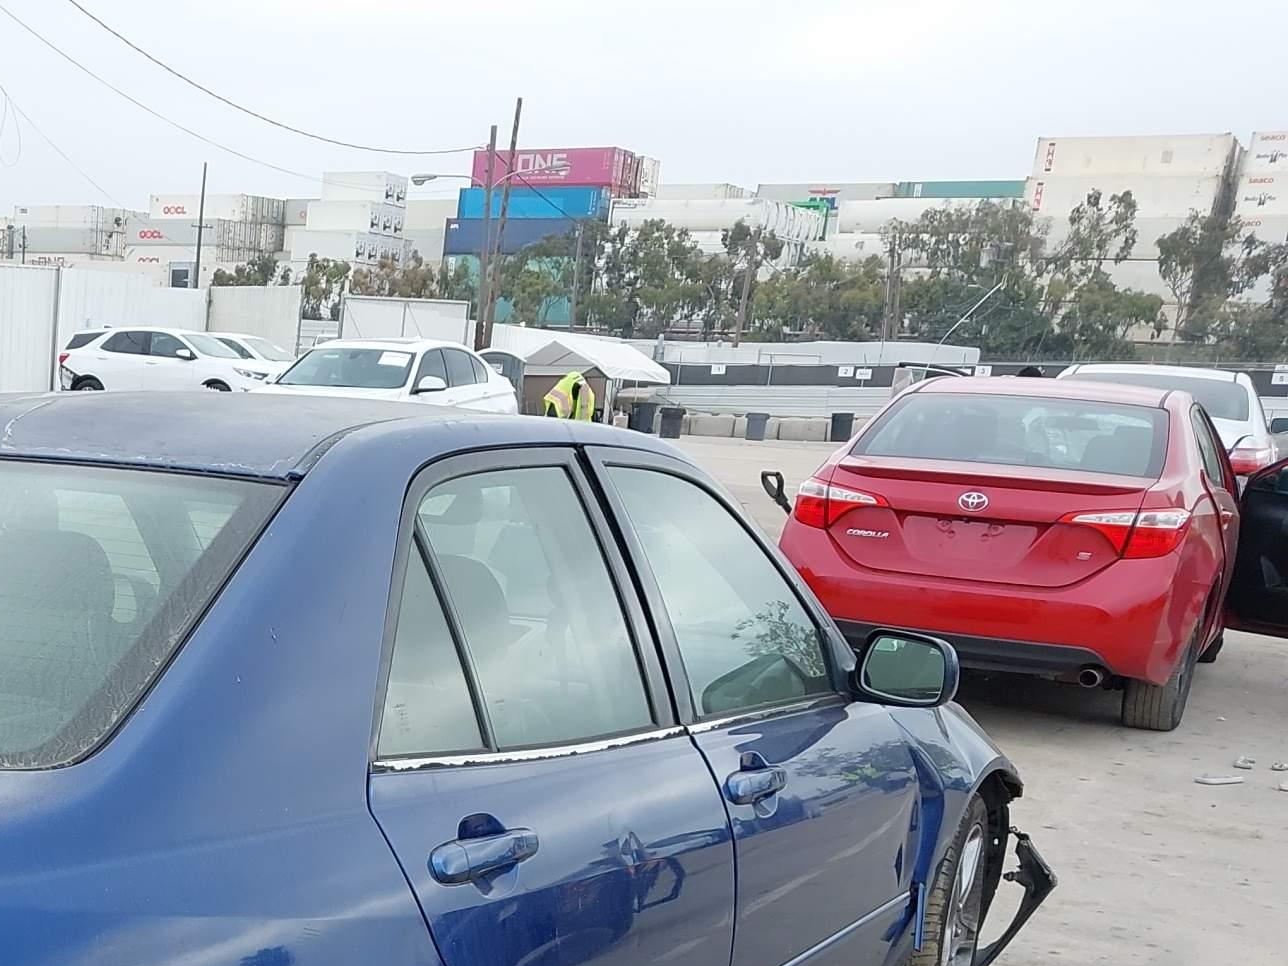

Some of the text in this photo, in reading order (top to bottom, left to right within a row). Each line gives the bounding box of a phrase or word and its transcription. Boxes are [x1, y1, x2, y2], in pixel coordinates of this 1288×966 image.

[517, 153, 570, 175] ONE
[163, 206, 187, 215] OOCL
[139, 230, 163, 239] OOCL
[846, 528, 890, 539] COROLLA
[1076, 551, 1092, 561] S
